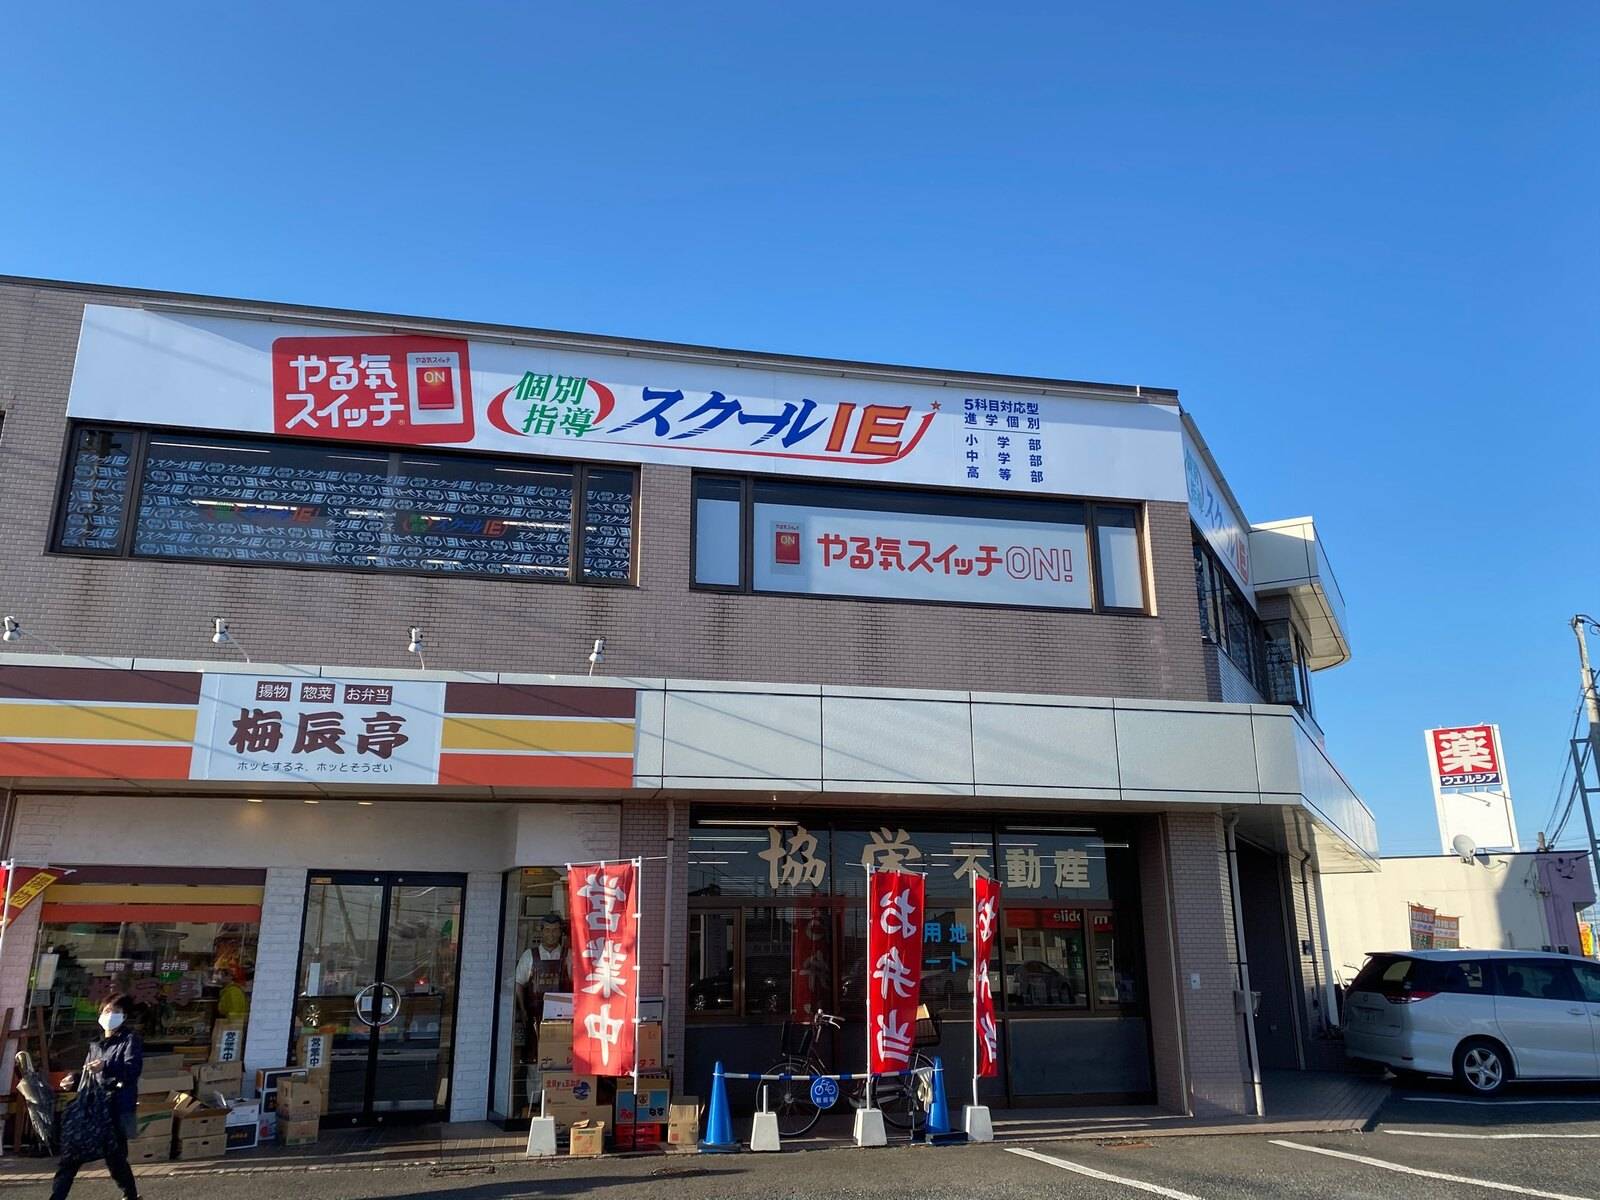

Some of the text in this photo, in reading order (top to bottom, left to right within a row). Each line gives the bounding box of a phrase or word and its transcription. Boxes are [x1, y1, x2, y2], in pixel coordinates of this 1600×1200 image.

[289, 354, 397, 391] やる気
[424, 371, 445, 383] ON
[514, 371, 588, 405] 個別
[285, 393, 405, 429] スイッチ
[522, 404, 602, 437] 指導
[606, 386, 912, 457] スクールIE
[964, 398, 1039, 415] 5科目対応型
[258, 685, 290, 699] 揚物
[303, 685, 332, 700] 惣菜
[346, 686, 390, 702] お弁当
[229, 708, 409, 760] 梅辰亭
[1439, 730, 1493, 773] 薬
[1441, 773, 1497, 785] ウエルシア
[577, 873, 628, 1066] 営業中
